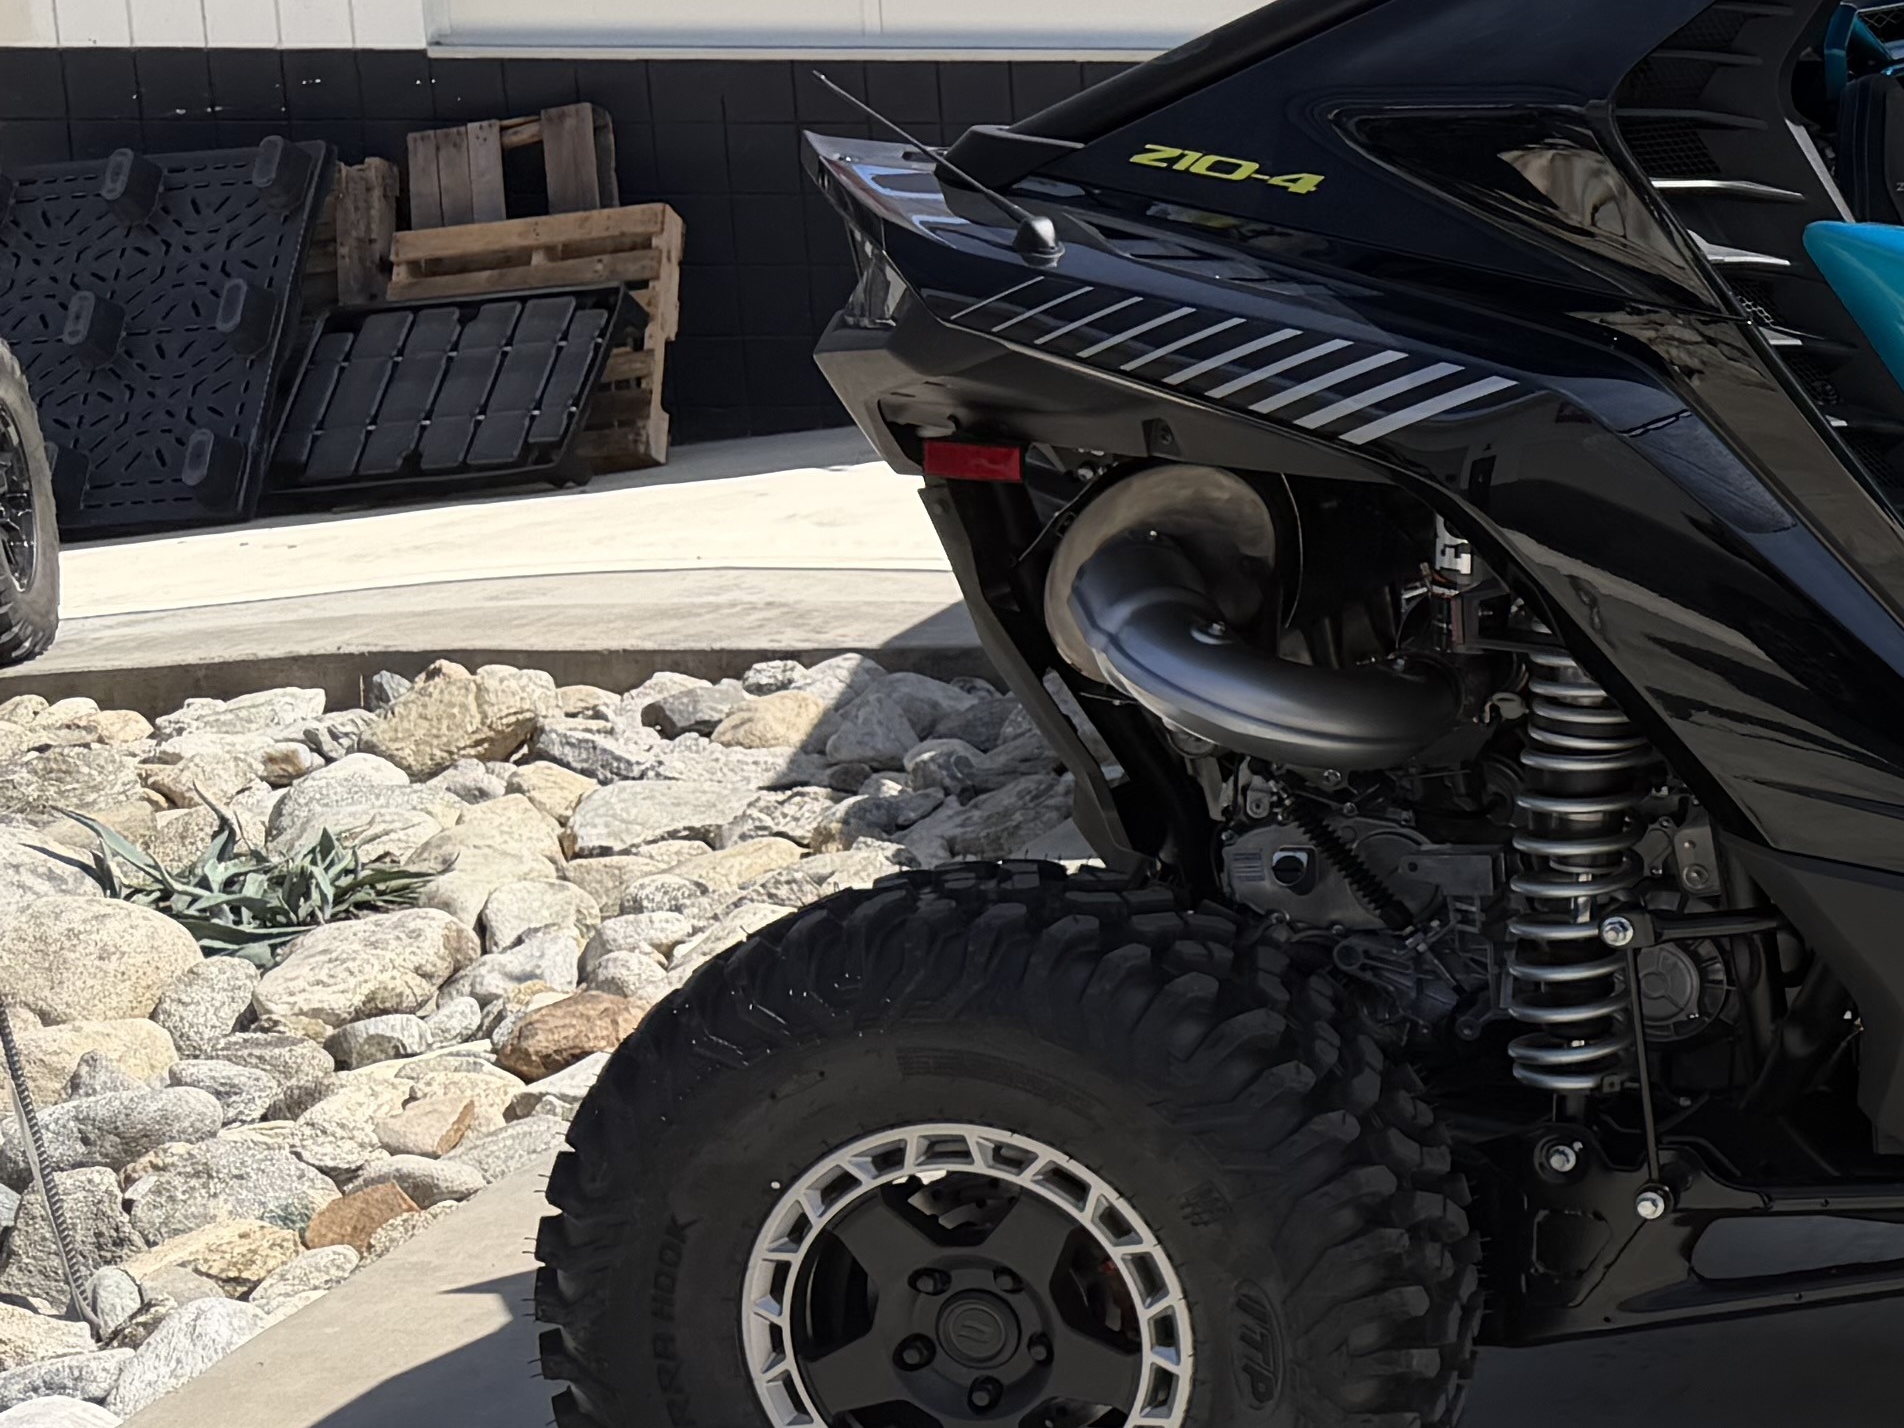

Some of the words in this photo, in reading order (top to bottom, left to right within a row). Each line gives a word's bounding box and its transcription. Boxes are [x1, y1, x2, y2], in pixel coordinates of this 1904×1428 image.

[1127, 142, 1326, 196] Z10-4
[649, 1212, 701, 1322] HOOK
[1236, 1291, 1279, 1408] ITP
